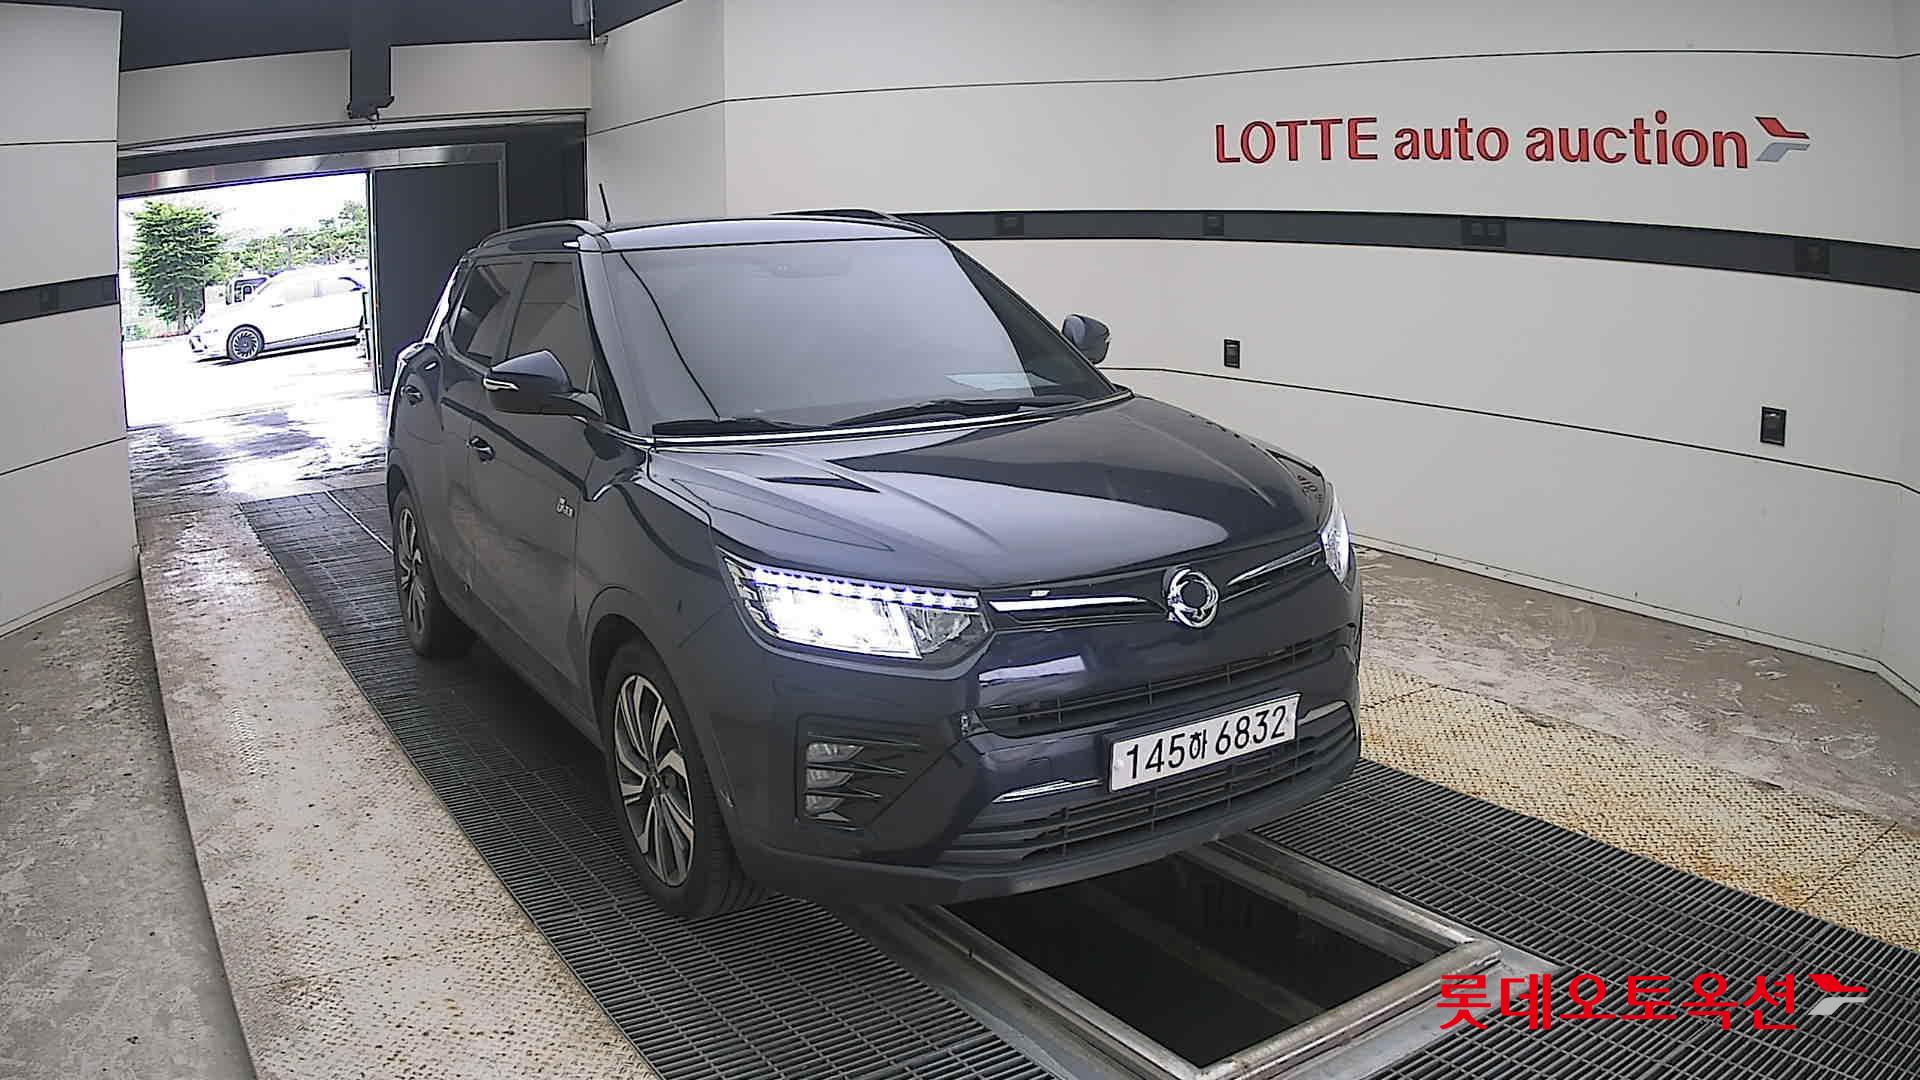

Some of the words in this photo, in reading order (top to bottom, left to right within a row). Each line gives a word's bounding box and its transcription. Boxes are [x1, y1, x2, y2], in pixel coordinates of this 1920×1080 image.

[1215, 116, 1378, 163] LOTTE
[1394, 117, 1510, 161] auto
[1525, 110, 1748, 168] auction
[1126, 729, 1208, 779] 145하
[1215, 705, 1287, 755] 6832
